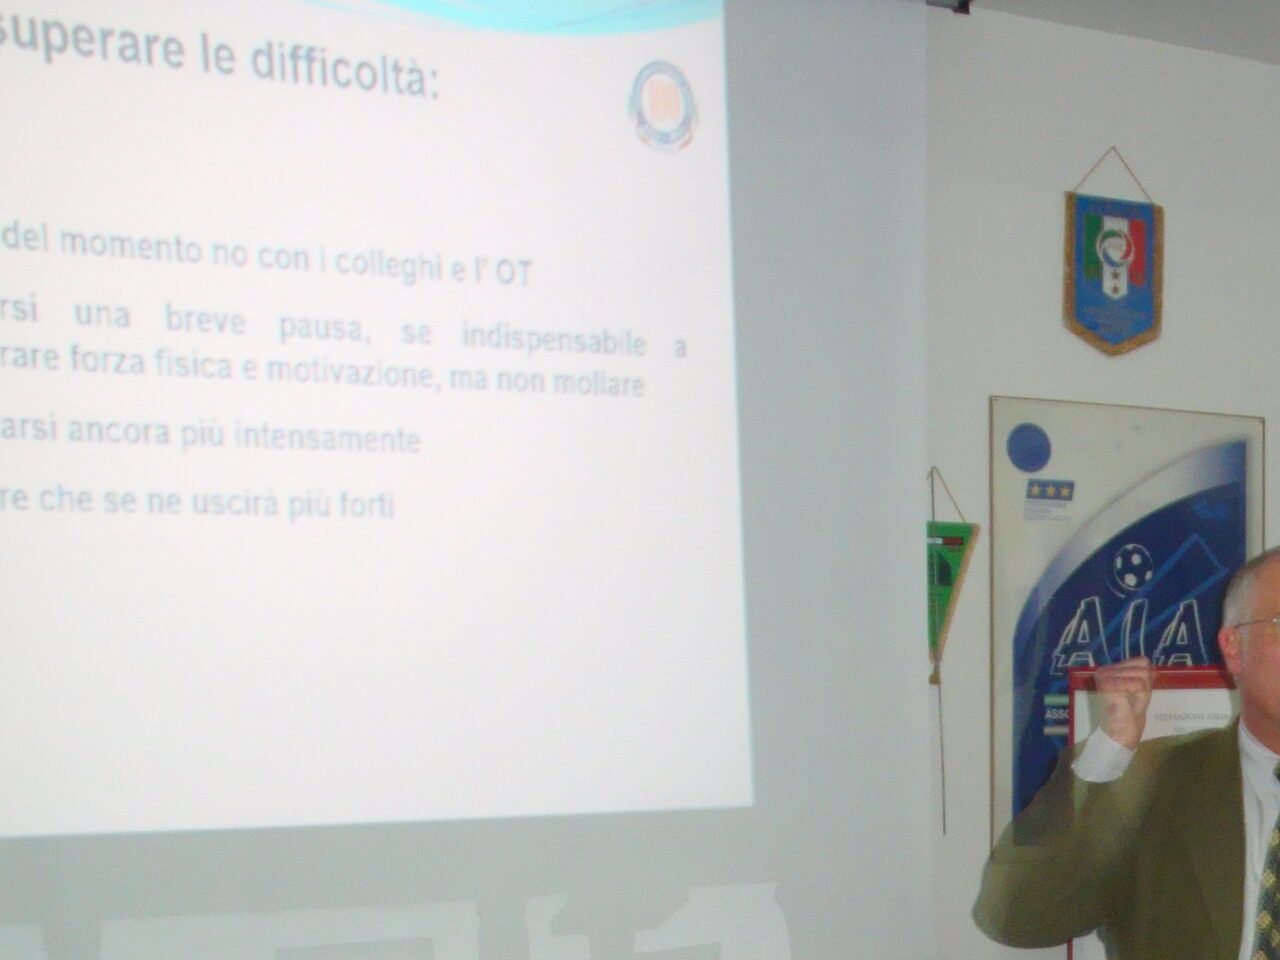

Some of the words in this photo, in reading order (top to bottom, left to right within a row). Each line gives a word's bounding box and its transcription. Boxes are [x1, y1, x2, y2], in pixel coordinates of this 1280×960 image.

[200, 31, 237, 76] le
[250, 40, 440, 100] difficoltà:
[0, 219, 49, 252] del
[59, 227, 203, 265] momento
[211, 241, 249, 269] no
[257, 245, 311, 273] con
[318, 243, 328, 274] i
[335, 245, 444, 288] colleghi
[450, 260, 467, 283] e
[495, 256, 533, 287] OT
[0, 291, 39, 323] rsi
[73, 301, 132, 329] una
[164, 301, 247, 336] breve
[278, 312, 373, 348] pausa,
[400, 321, 433, 347] se
[461, 318, 647, 358] indispensabile
[673, 336, 689, 359] a
[0, 344, 60, 371] rare
[69, 342, 145, 376] forza
[153, 347, 234, 380] fisica
[240, 358, 259, 382] e
[266, 354, 443, 394] motivazione,
[448, 367, 489, 393] ma
[496, 369, 547, 395] non
[553, 368, 647, 399] mollare
[0, 411, 58, 443] arsi
[67, 416, 172, 446] ancora
[180, 417, 226, 454] più
[233, 420, 422, 455] intensamente
[0, 486, 29, 512] re
[38, 482, 93, 513] che
[102, 488, 138, 514] se
[146, 490, 183, 515] ne
[191, 487, 280, 518] uscirà
[287, 487, 332, 524] più
[337, 487, 396, 520] forti
